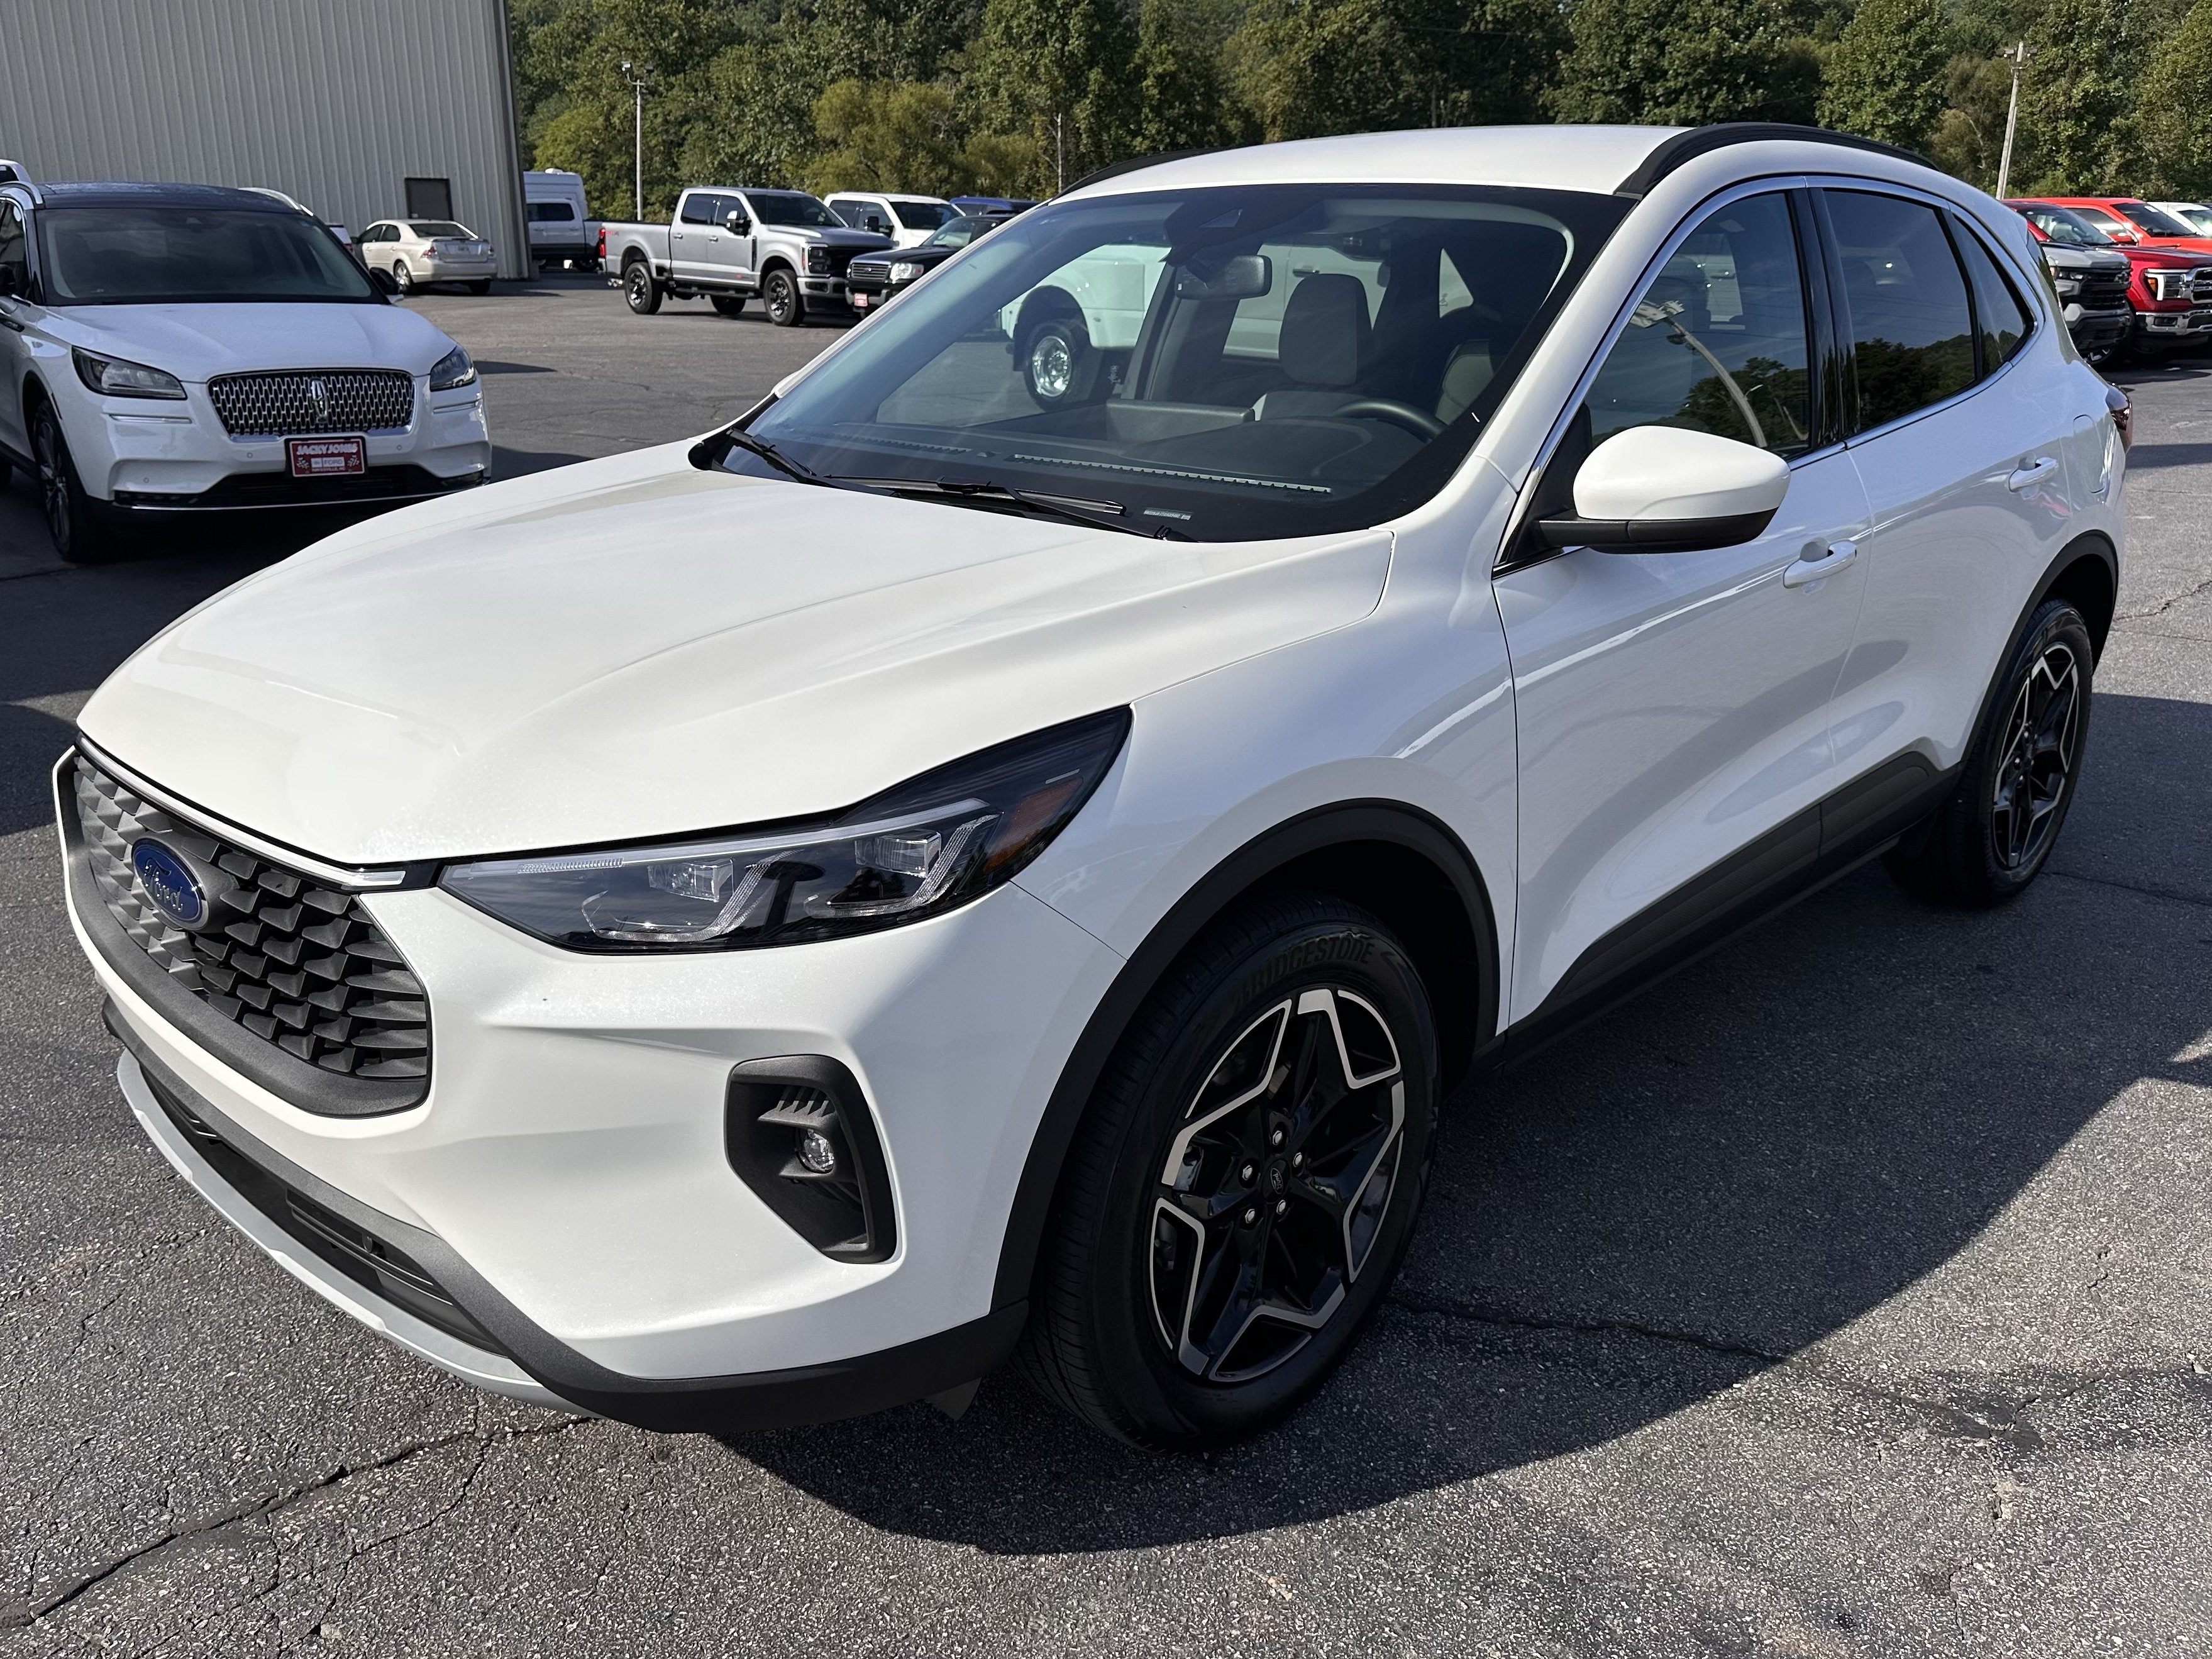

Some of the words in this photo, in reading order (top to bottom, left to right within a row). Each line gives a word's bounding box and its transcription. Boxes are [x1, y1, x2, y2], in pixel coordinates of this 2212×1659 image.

[296, 444, 328, 455] JACKY
[328, 443, 358, 453] JONES
[143, 858, 183, 913] Ford
[1233, 936, 1375, 1006] BRIDGESTONE
